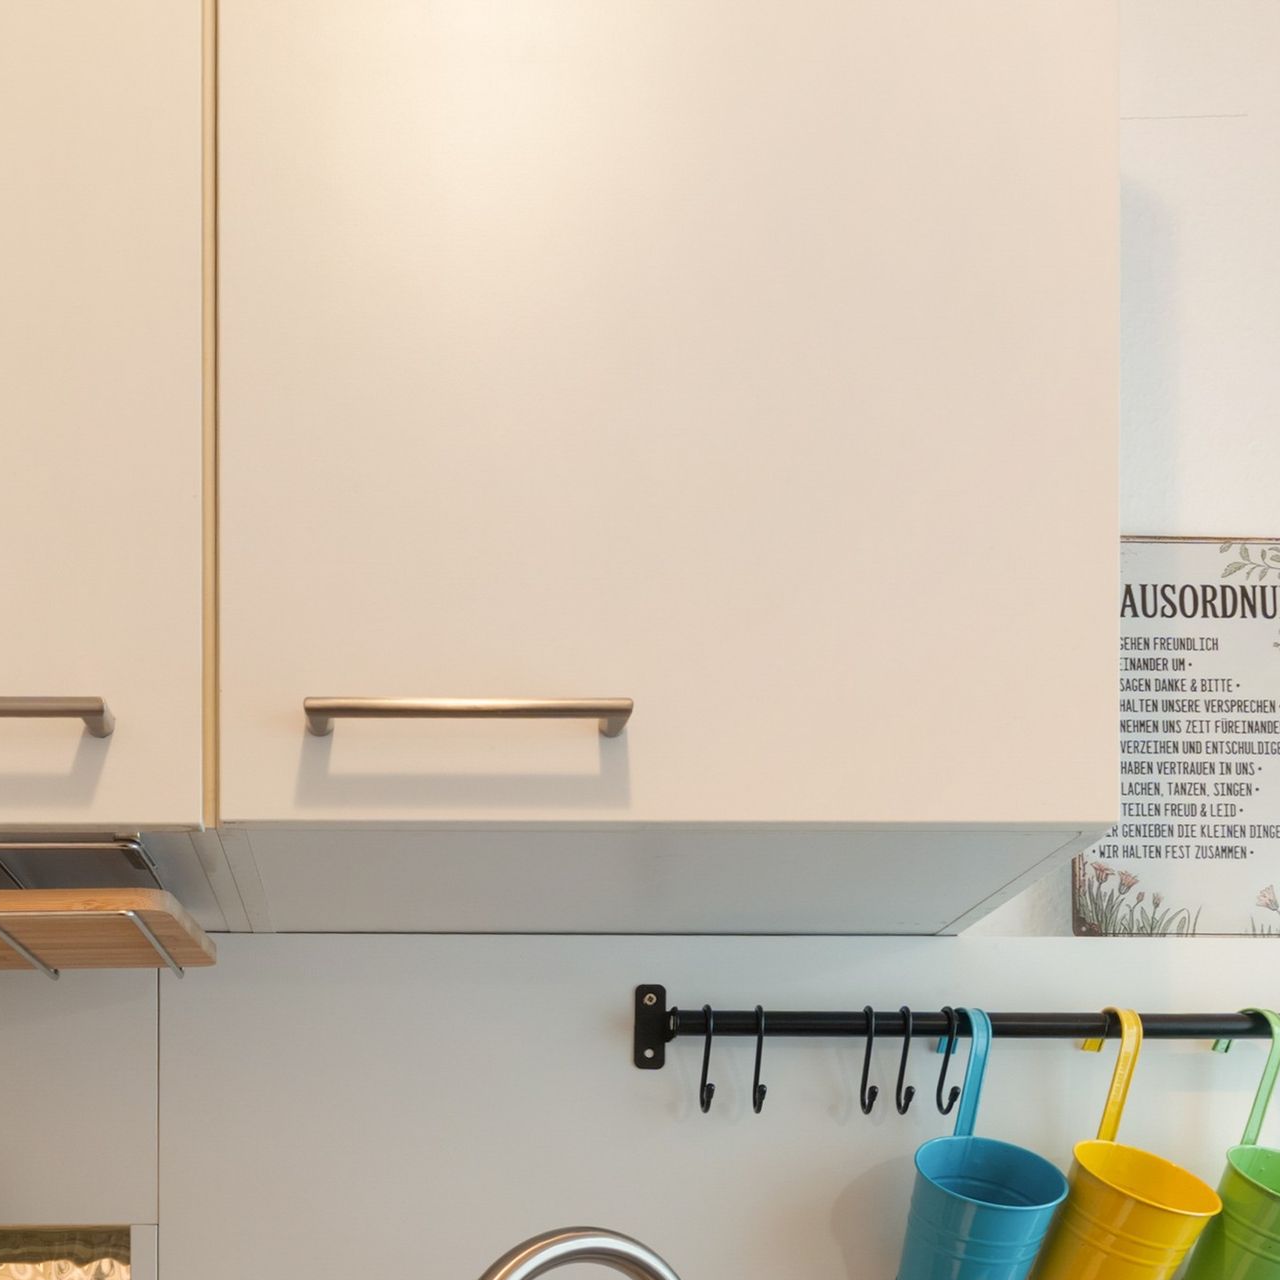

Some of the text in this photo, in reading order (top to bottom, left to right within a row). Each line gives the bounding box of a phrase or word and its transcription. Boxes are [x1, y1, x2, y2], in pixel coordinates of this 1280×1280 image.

[1153, 637, 1219, 651] FREUNDLICH
[1172, 658, 1185, 671] UM
[1120, 678, 1233, 693] SAGEN DANKE & BITTE
[1120, 699, 1276, 713] HALTEN UNSERE VERSPRECHEN
[1120, 719, 1159, 733] NEHMEN
[1162, 720, 1181, 733] UNS
[1185, 720, 1211, 733] ZEIT
[1120, 740, 1179, 754] VERZEIHEN
[1182, 740, 1201, 754] UND
[1120, 761, 1255, 776] HABEN VERTRAUEN IN UNS
[1121, 782, 1164, 797] LACHEN,
[1213, 783, 1252, 797] SINGEN
[1122, 803, 1236, 817] TEILEN FREUD & LEID
[1177, 824, 1197, 838] DIE
[1200, 825, 1246, 838] KLEINEN
[1099, 845, 1247, 859] WIR HALTEN FEST ZUSAMMEN
